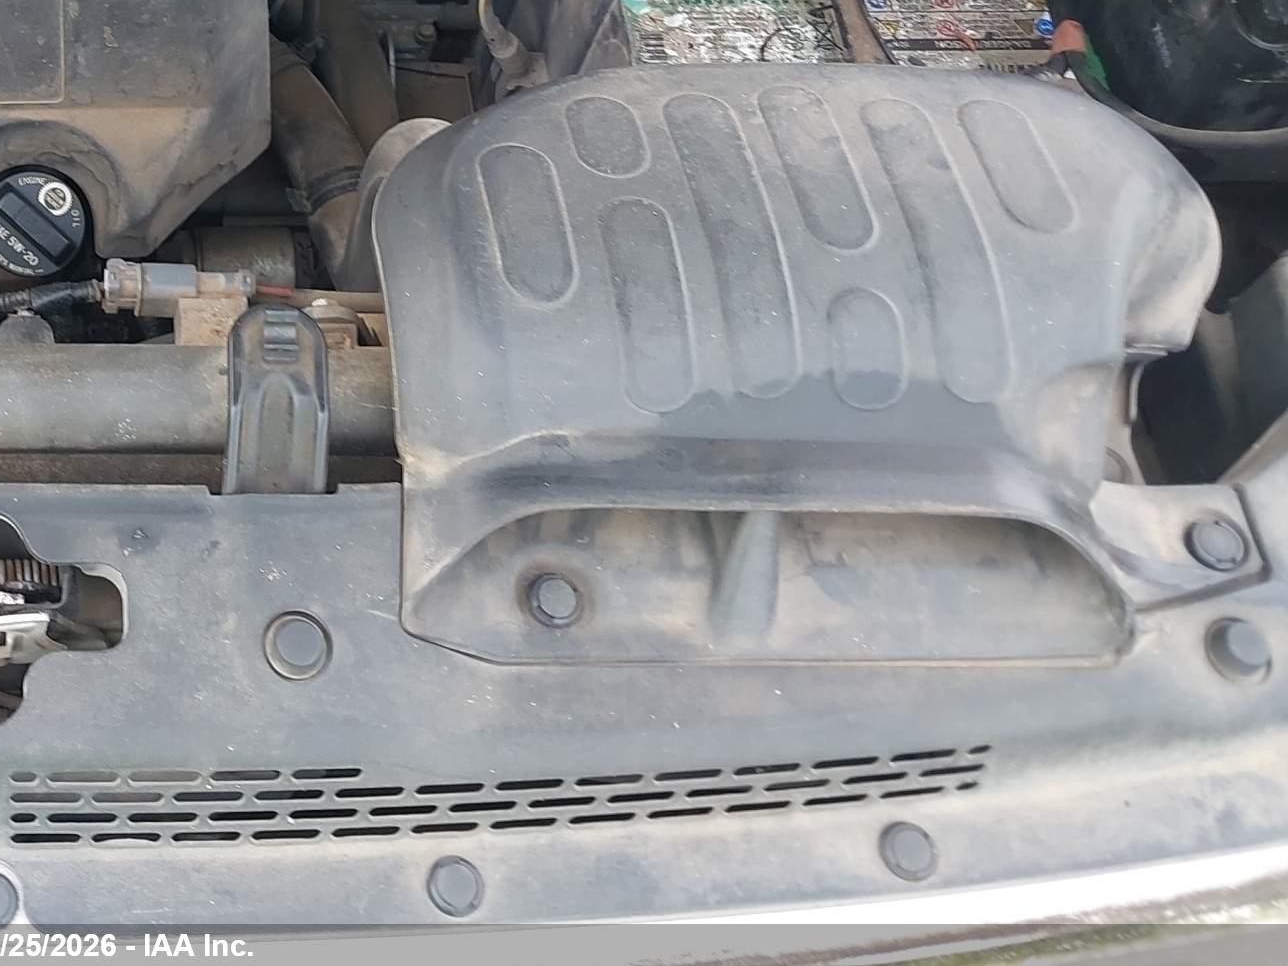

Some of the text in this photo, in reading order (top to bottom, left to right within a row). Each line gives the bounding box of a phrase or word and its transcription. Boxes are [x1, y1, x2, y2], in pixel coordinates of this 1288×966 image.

[17, 176, 81, 227] ENGINE OIL
[7, 236, 39, 266] 5W-20
